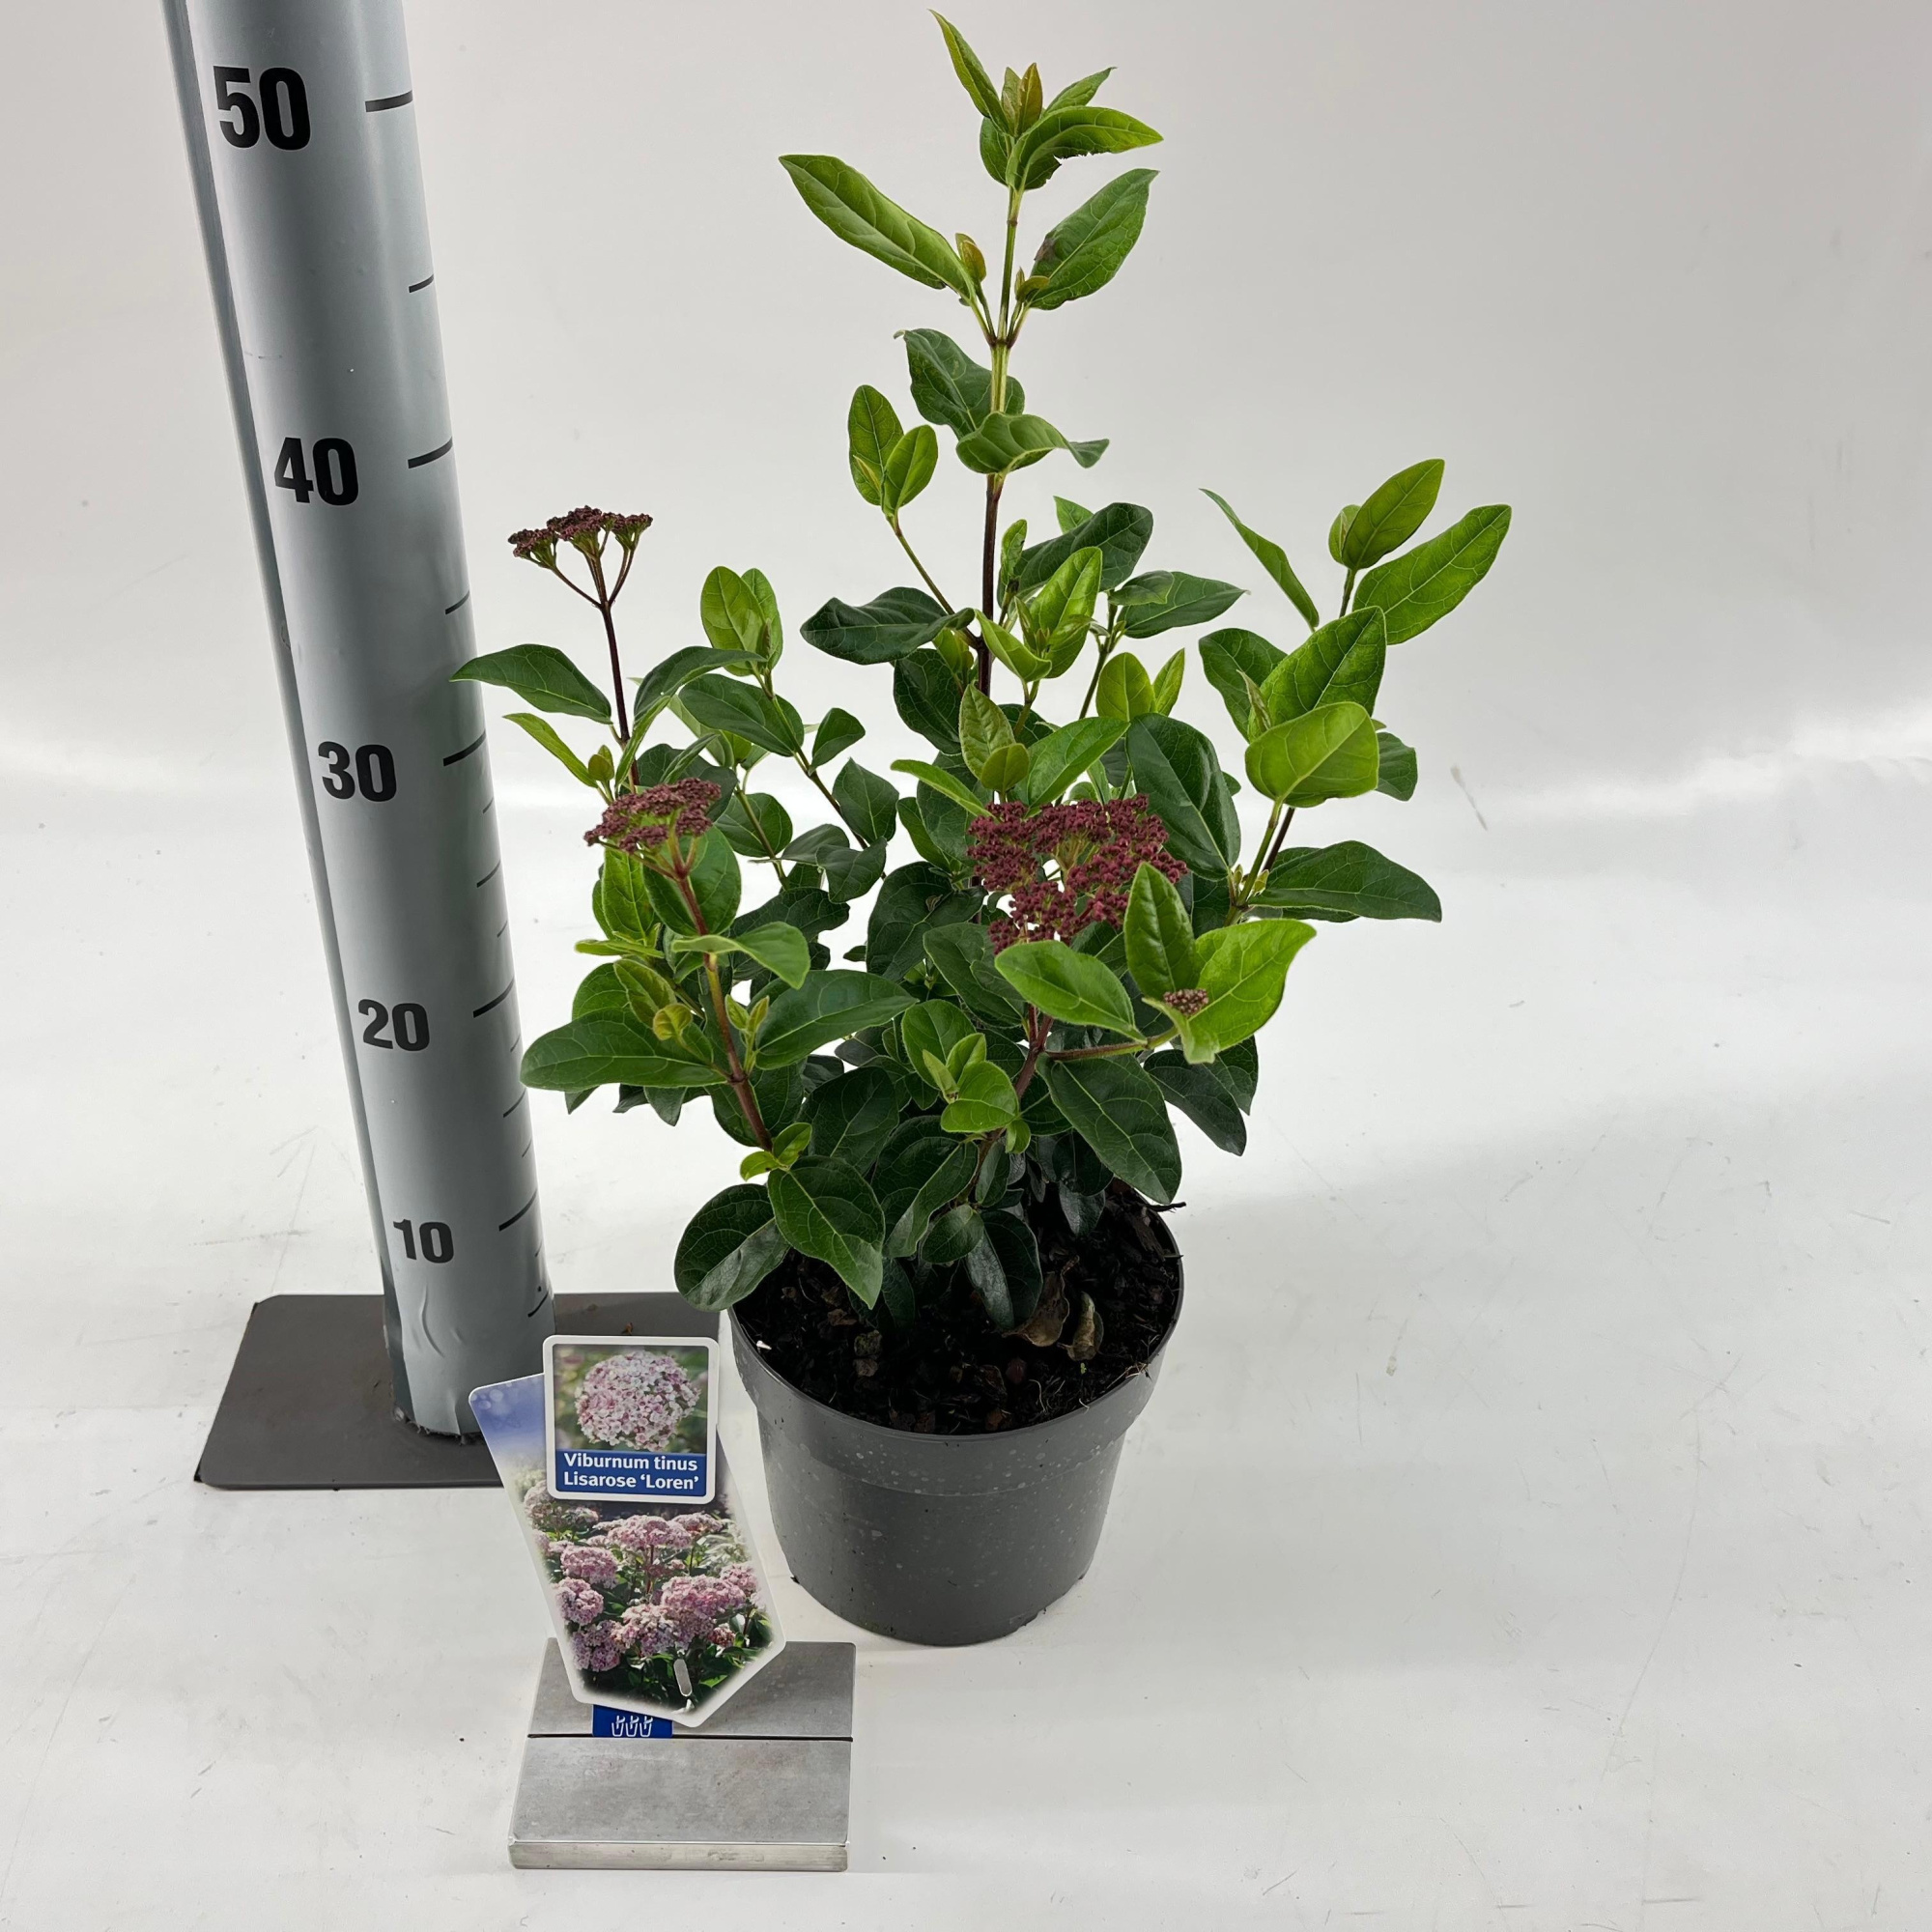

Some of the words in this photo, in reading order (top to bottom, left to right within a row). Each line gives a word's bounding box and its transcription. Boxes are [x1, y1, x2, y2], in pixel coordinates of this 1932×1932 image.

[213, 66, 311, 152] 50
[275, 436, 359, 507] 40
[318, 740, 398, 803] 30
[358, 998, 431, 1053] 20
[393, 1217, 455, 1265] 10
[563, 1452, 649, 1469] Viburnum
[654, 1456, 698, 1471] tinus
[563, 1471, 637, 1488] Lisarose
